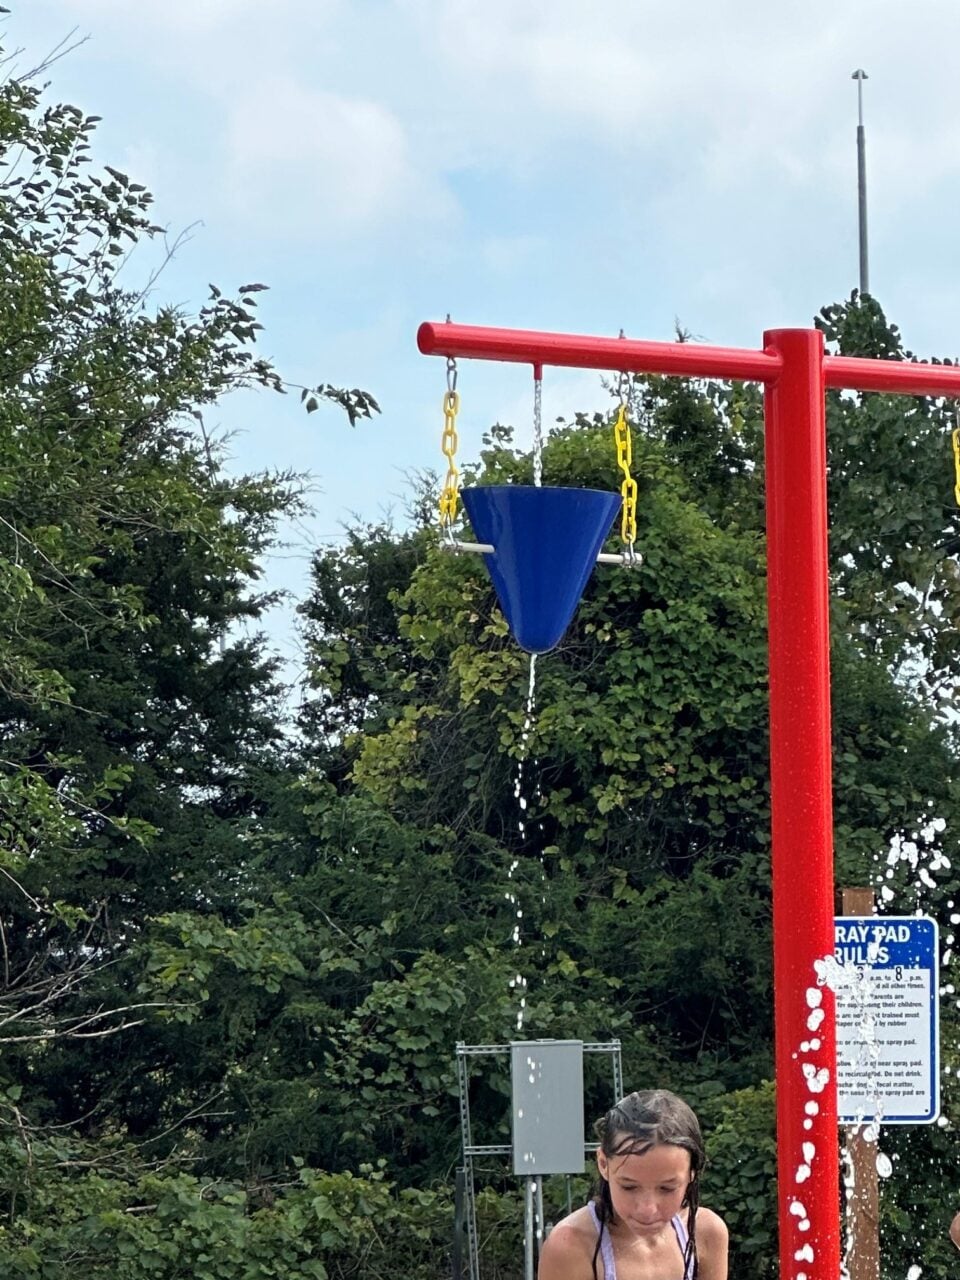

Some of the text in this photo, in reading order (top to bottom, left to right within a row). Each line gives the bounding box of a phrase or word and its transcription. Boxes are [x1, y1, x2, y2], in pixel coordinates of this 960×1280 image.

[834, 926, 910, 943] RAY PAD
[834, 947, 889, 964] RULS
[895, 966, 903, 981] 8
